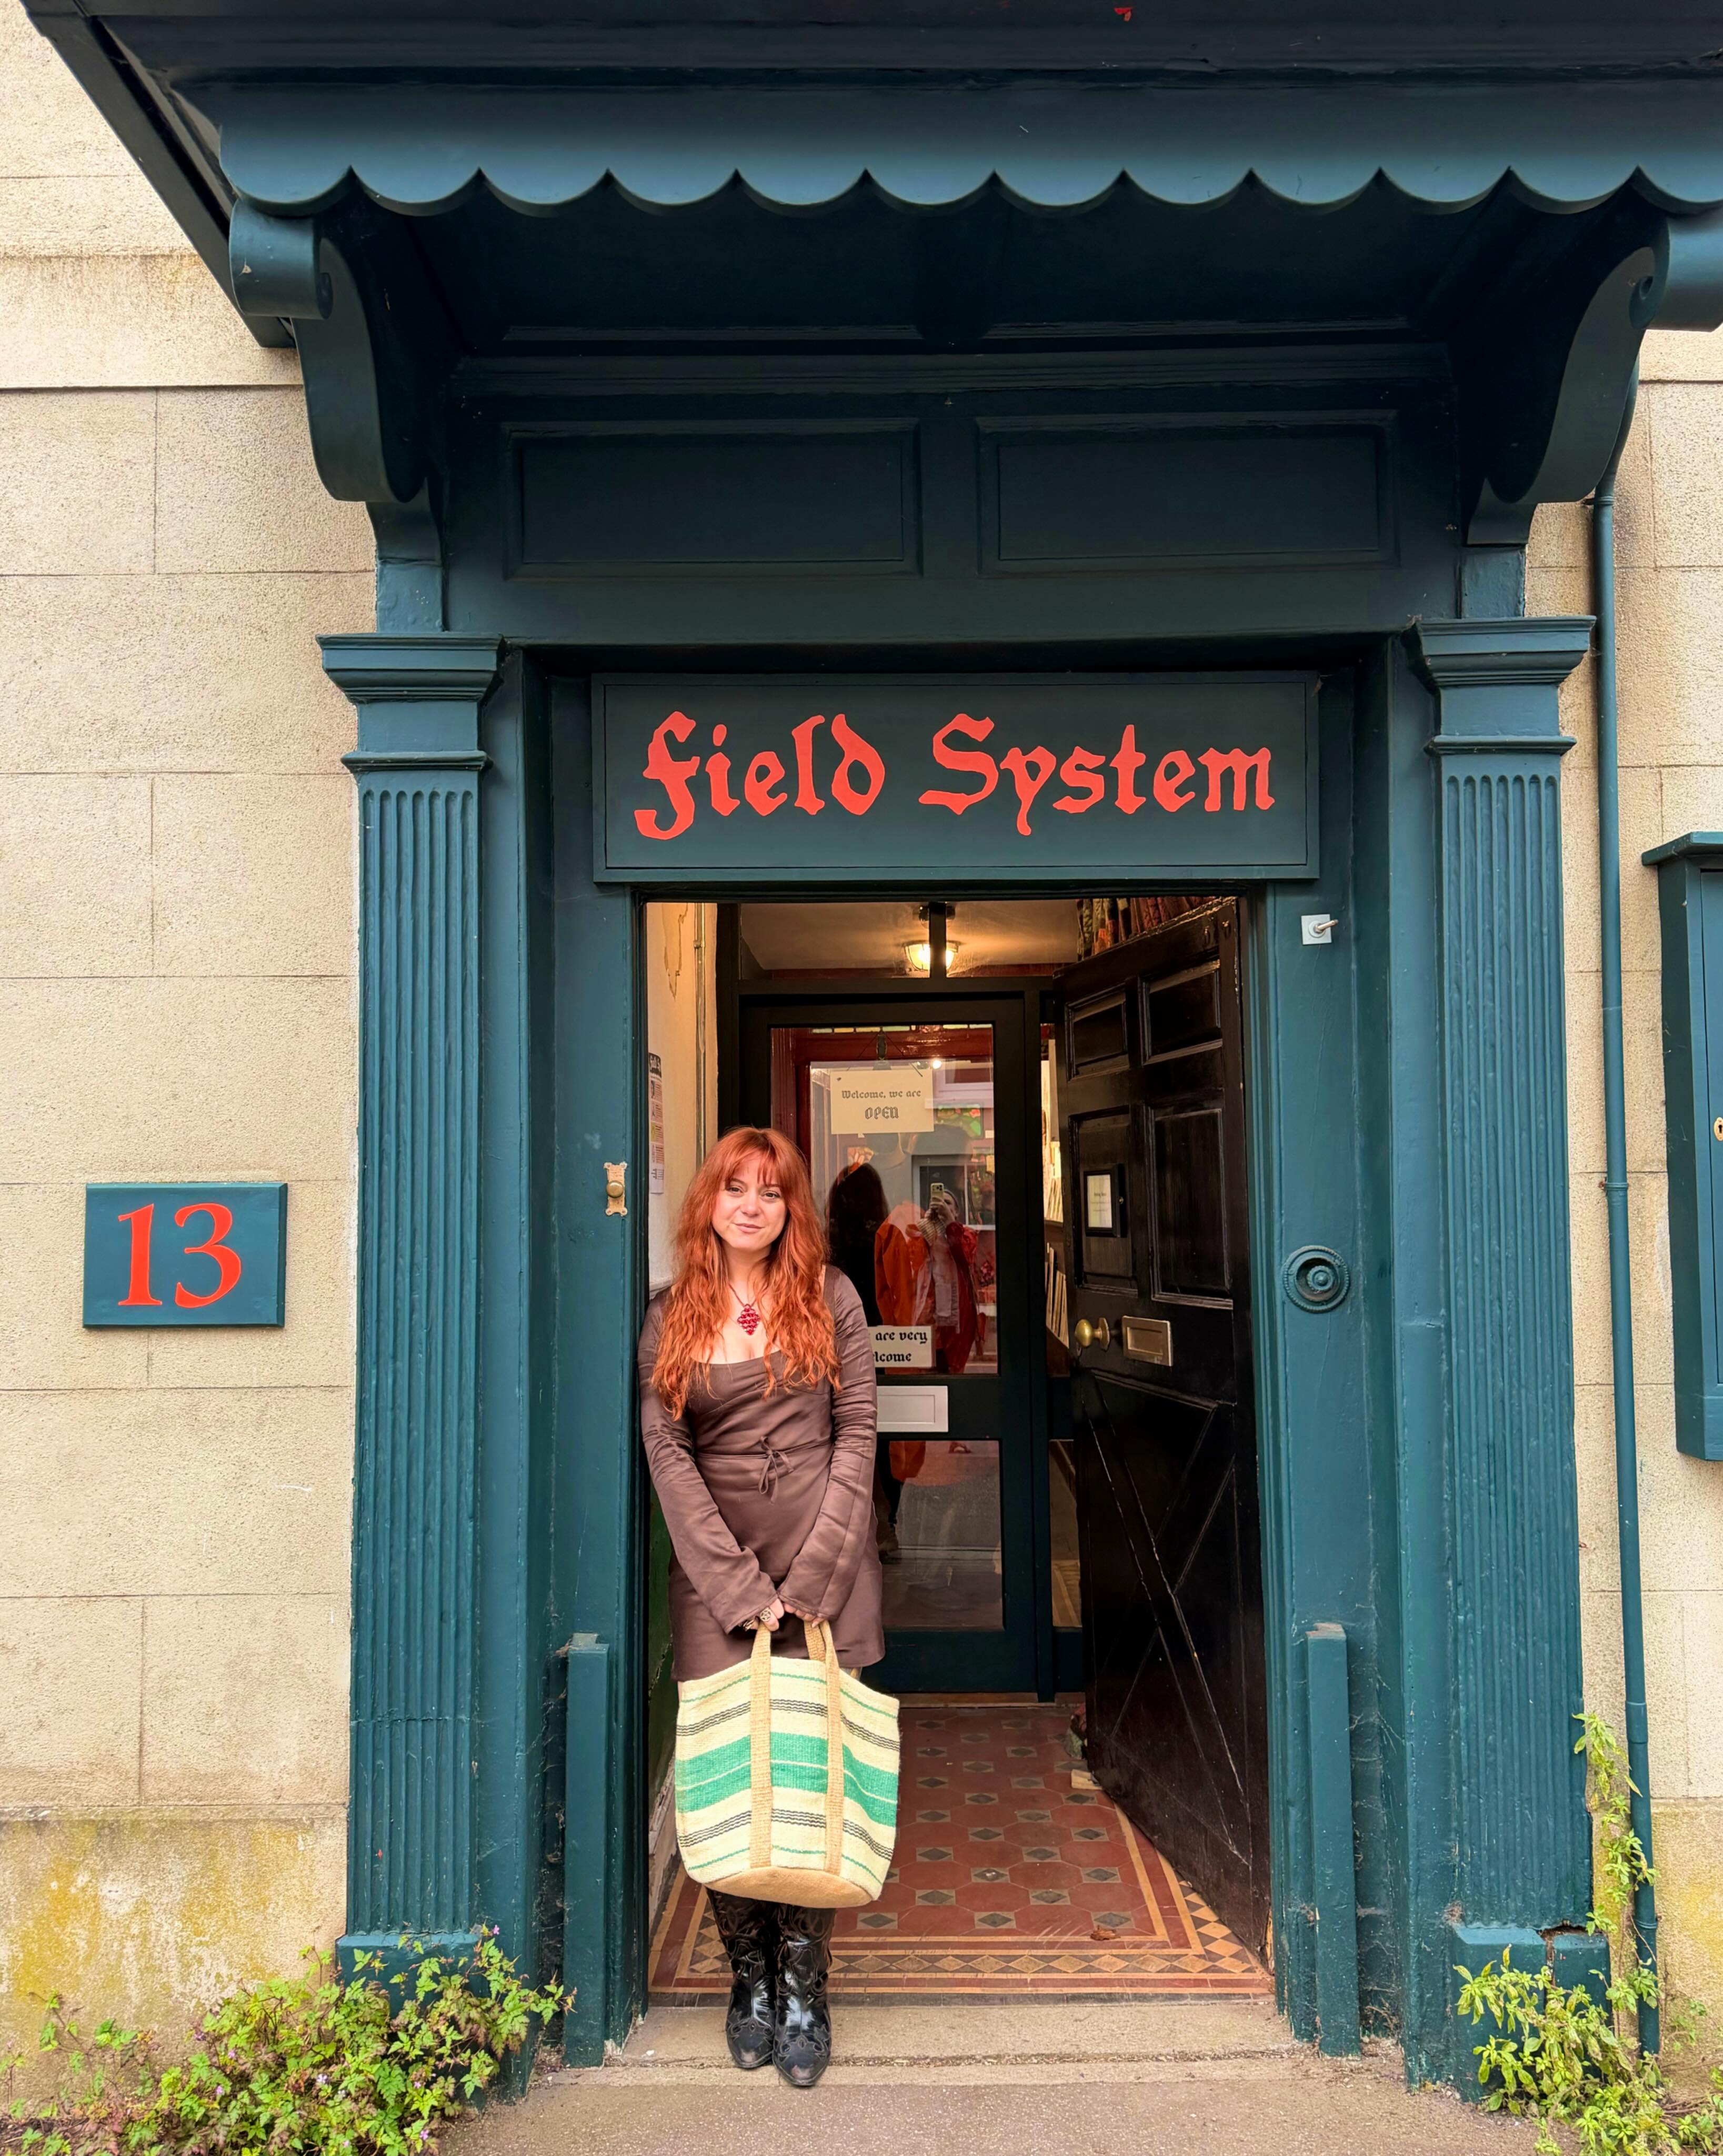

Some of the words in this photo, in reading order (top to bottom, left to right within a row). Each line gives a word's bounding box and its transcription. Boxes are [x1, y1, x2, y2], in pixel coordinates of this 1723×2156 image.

[918, 713, 1275, 836] System
[865, 1106, 899, 1120] OPEN
[118, 1203, 242, 1309] 13
[875, 1332, 895, 1341] are
[899, 1331, 927, 1344] very
[873, 1351, 911, 1362] lcome
